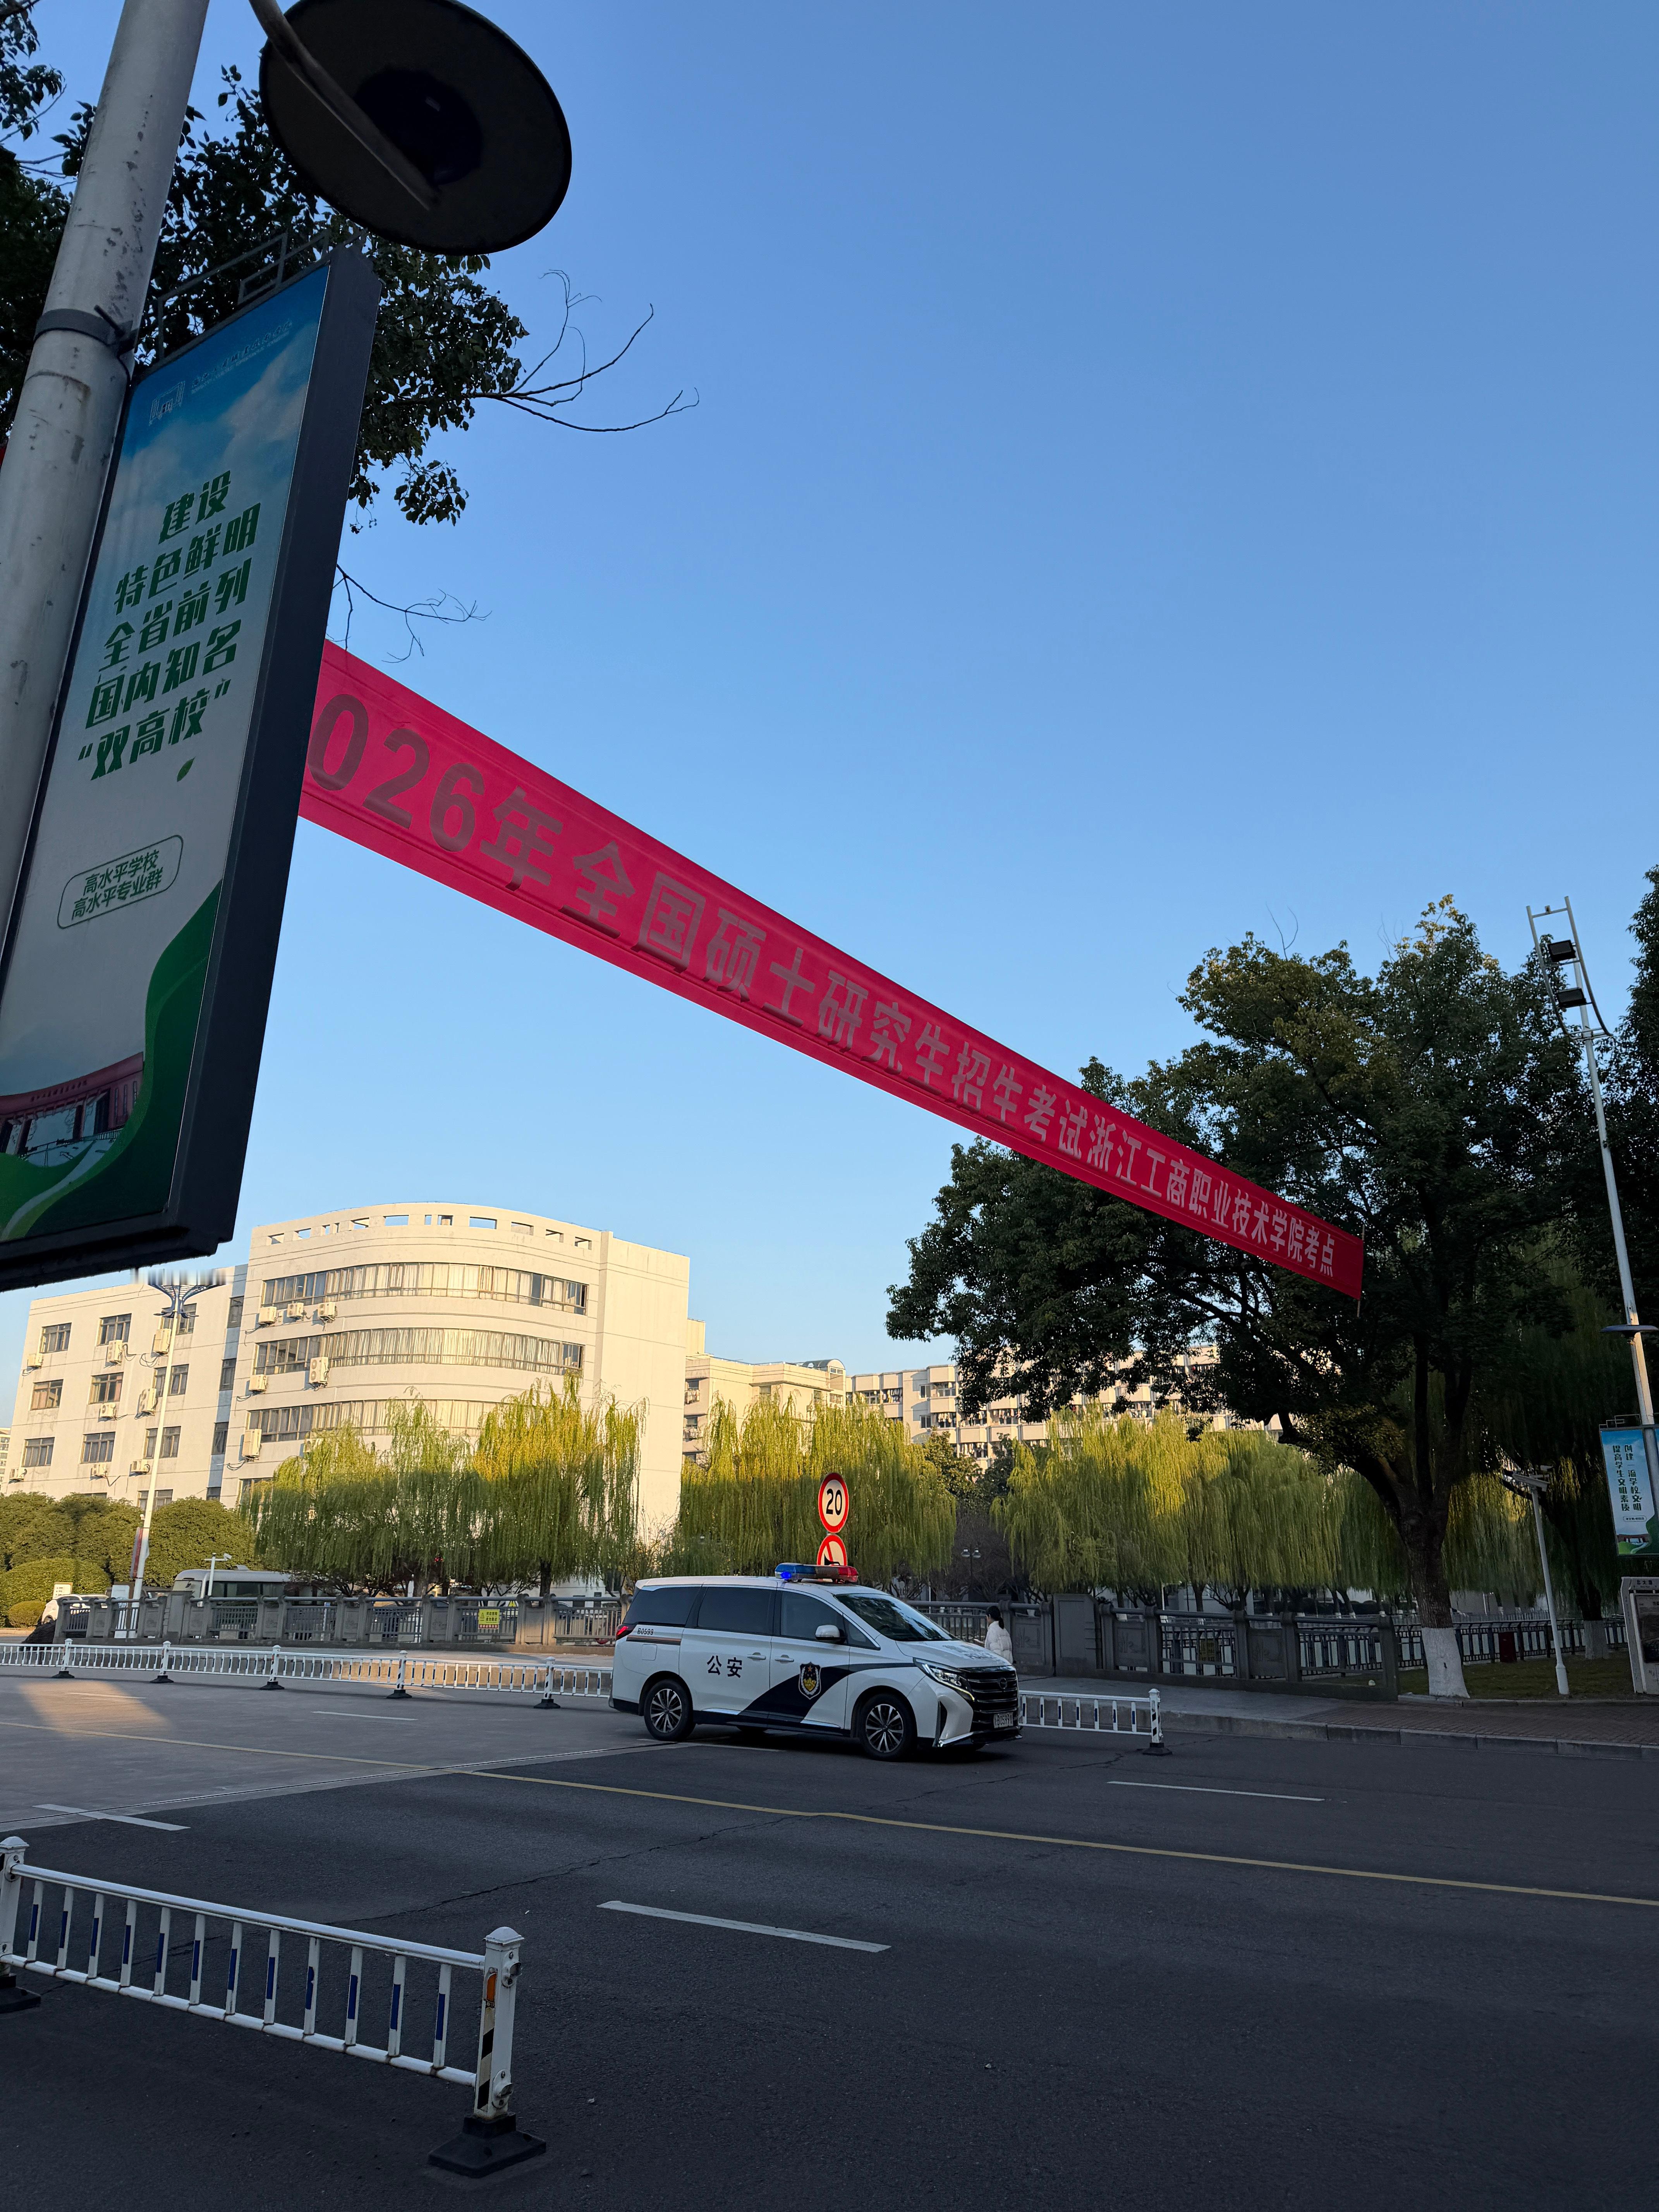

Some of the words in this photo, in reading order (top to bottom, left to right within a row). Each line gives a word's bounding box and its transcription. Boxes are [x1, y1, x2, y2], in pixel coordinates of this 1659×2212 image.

[159, 470, 231, 544] 建设
[114, 503, 261, 616] 特色鲜明
[99, 558, 252, 672] 全省前列
[86, 619, 241, 729] 国内知名
[71, 867, 163, 921] 高水平专业群
[83, 849, 159, 896] 高水平学校
[826, 1489, 842, 1515] 20
[707, 1655, 742, 1678] 公安
[994, 1714, 1012, 1726] B0599
